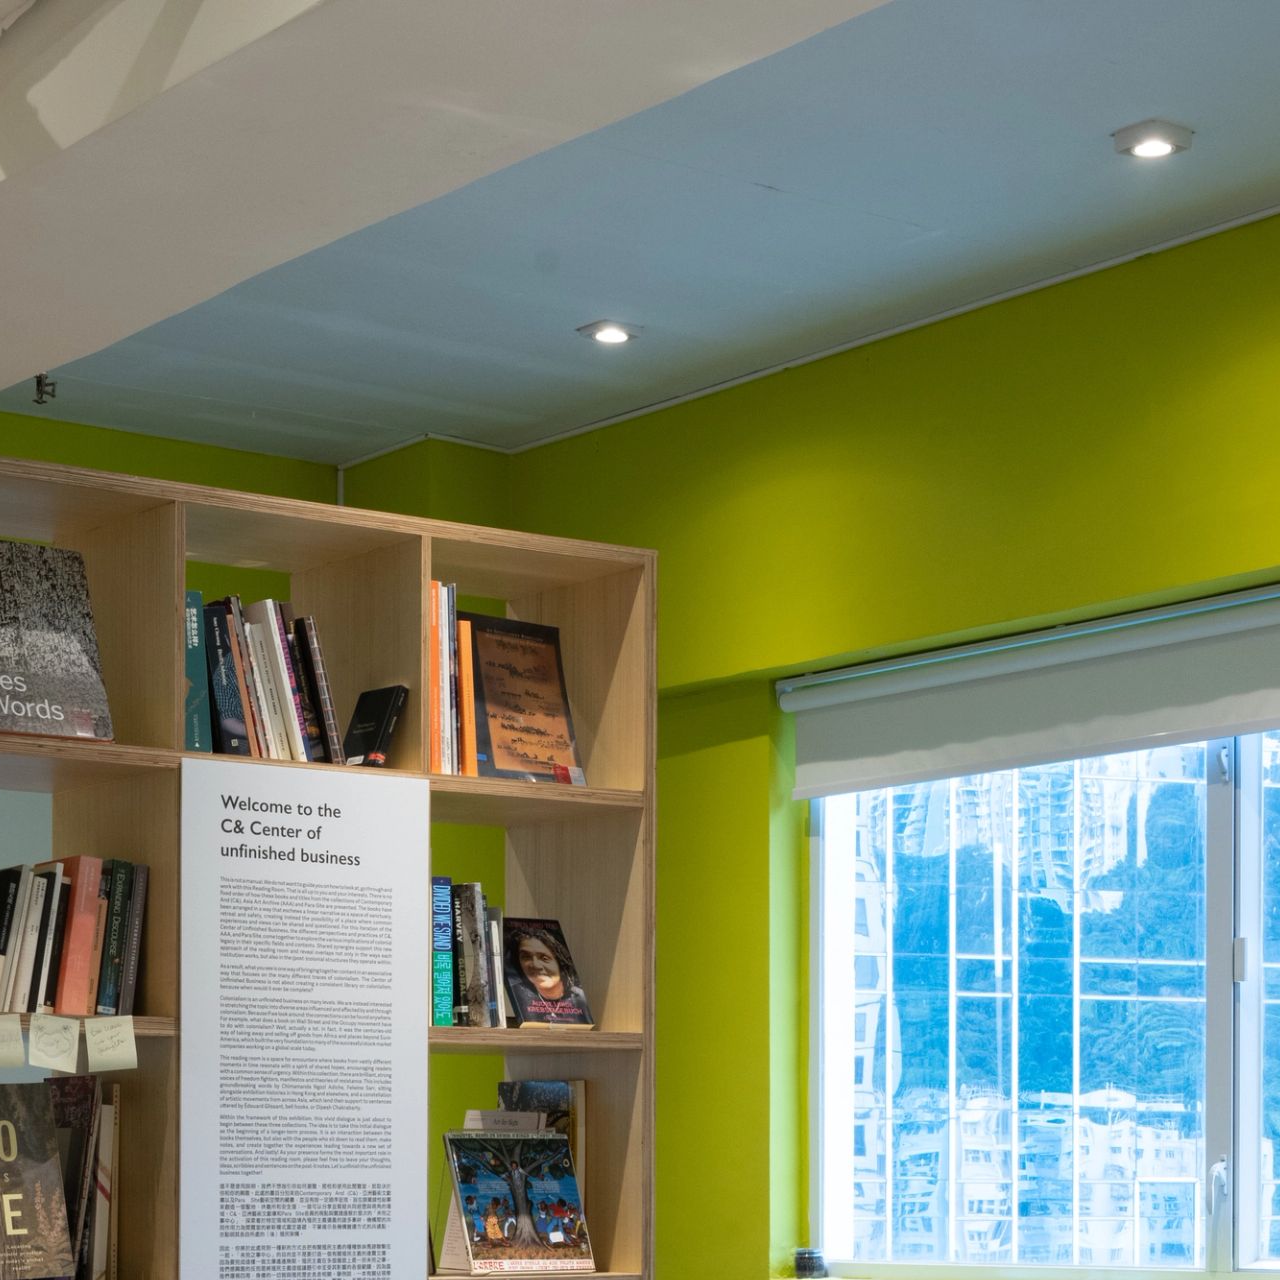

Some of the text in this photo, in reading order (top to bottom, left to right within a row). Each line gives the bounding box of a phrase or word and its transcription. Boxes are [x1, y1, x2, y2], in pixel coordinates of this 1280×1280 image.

[221, 794, 341, 818] Welcome to the
[221, 819, 322, 840] C& Center of
[221, 844, 361, 866] unfinished business
[433, 885, 451, 950] DIVIDED WE STAND
[455, 900, 463, 942] HARVEY
[109, 916, 121, 957] DISCOURSE
